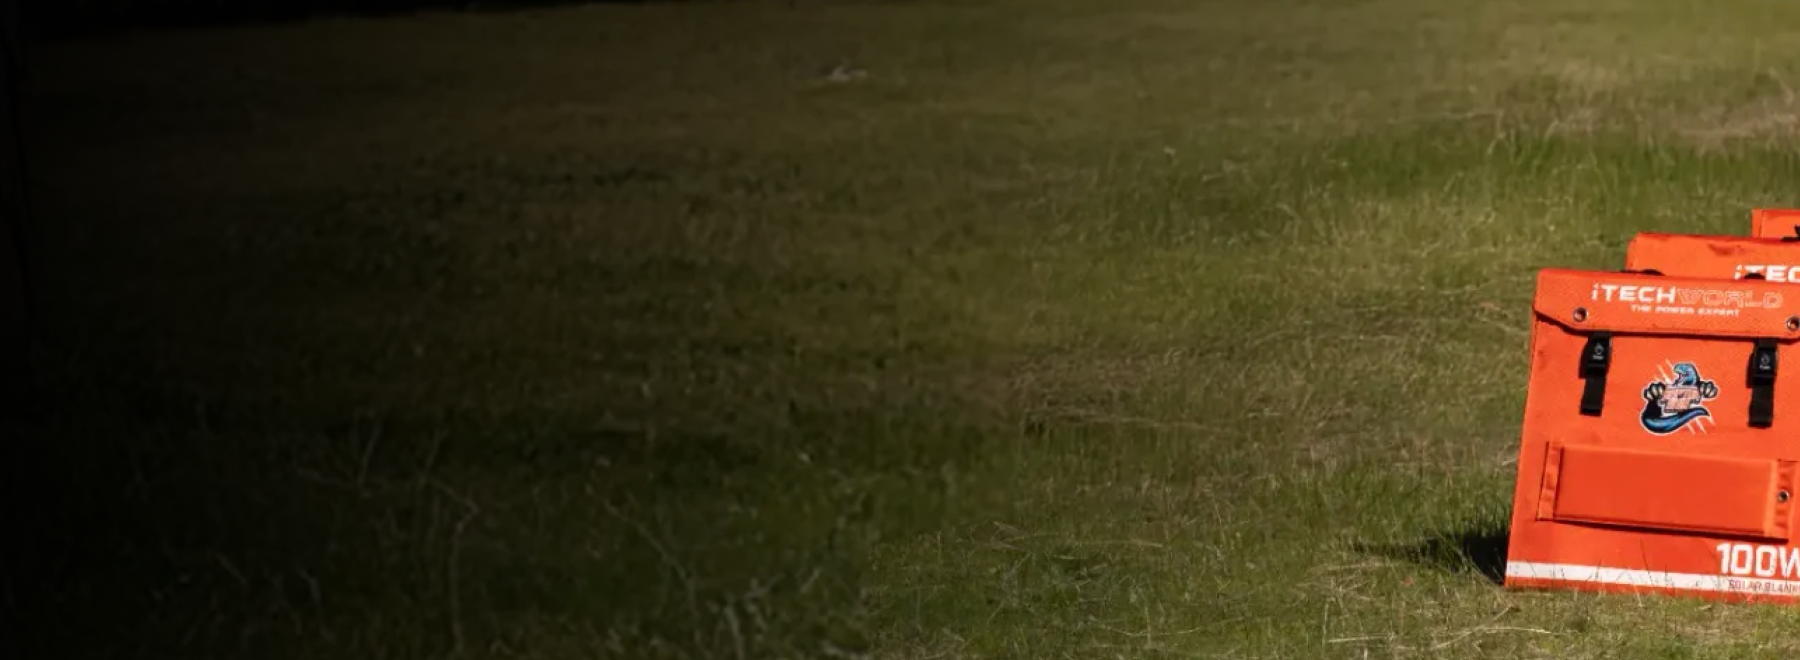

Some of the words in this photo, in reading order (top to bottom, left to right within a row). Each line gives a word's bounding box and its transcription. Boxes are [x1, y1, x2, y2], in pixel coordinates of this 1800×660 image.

[1631, 304, 1652, 313] THE
[1655, 306, 1695, 315] POWER
[1697, 307, 1740, 317] EXPERT
